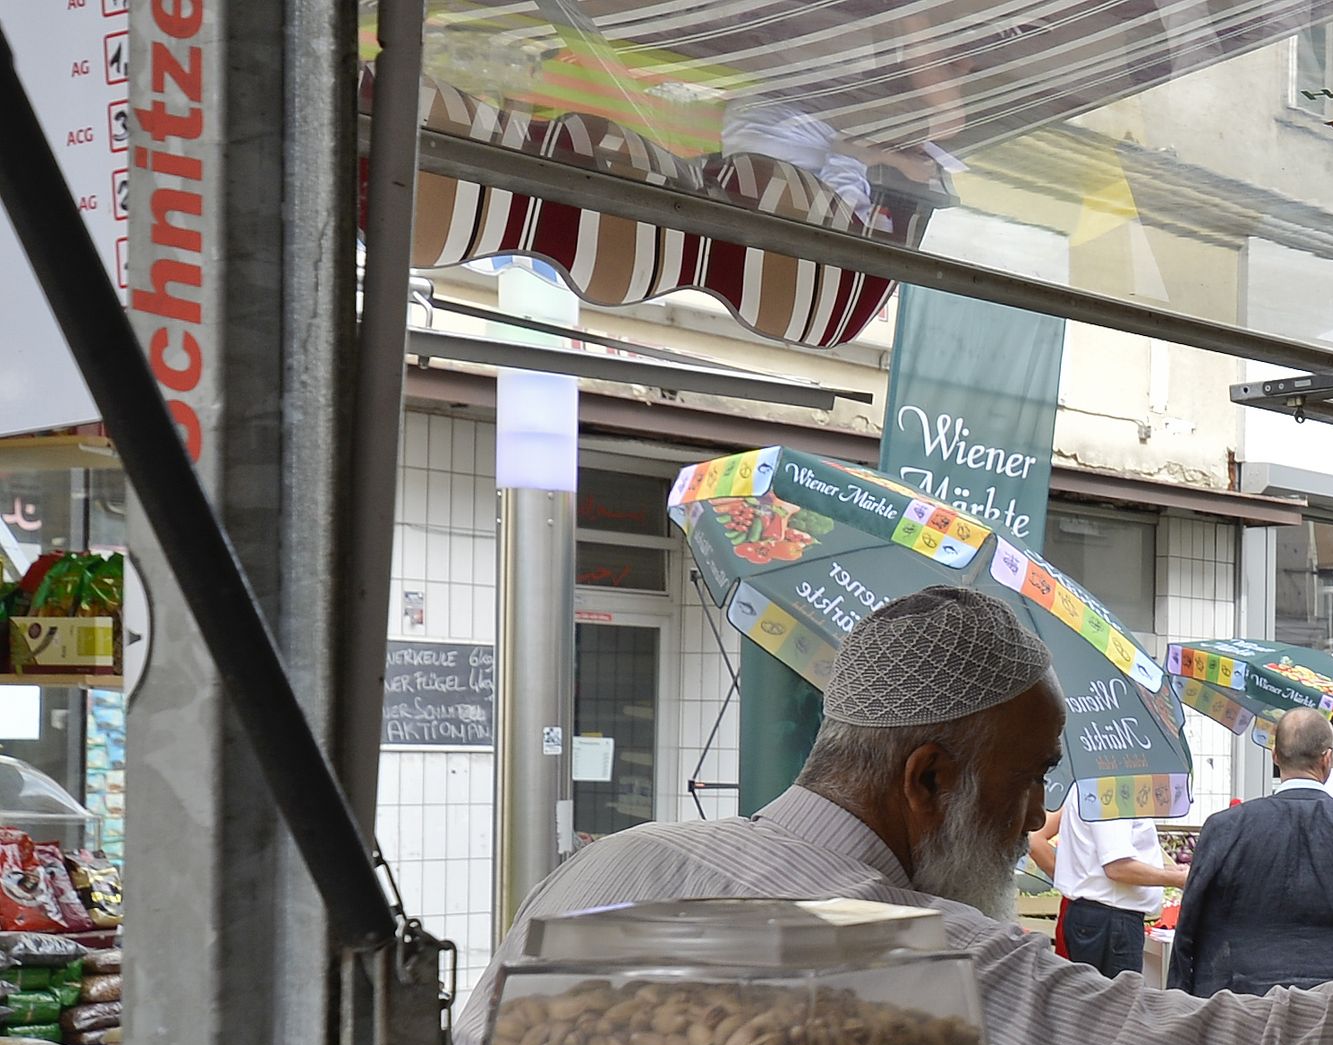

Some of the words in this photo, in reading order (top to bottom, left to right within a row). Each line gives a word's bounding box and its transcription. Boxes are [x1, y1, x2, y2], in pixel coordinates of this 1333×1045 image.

[71, 60, 91, 78] AG
[66, 127, 95, 147] ACG
[79, 195, 97, 213] AG
[898, 405, 1036, 479] Wiener
[785, 462, 840, 498] Wiener
[838, 484, 898, 520] Märkte
